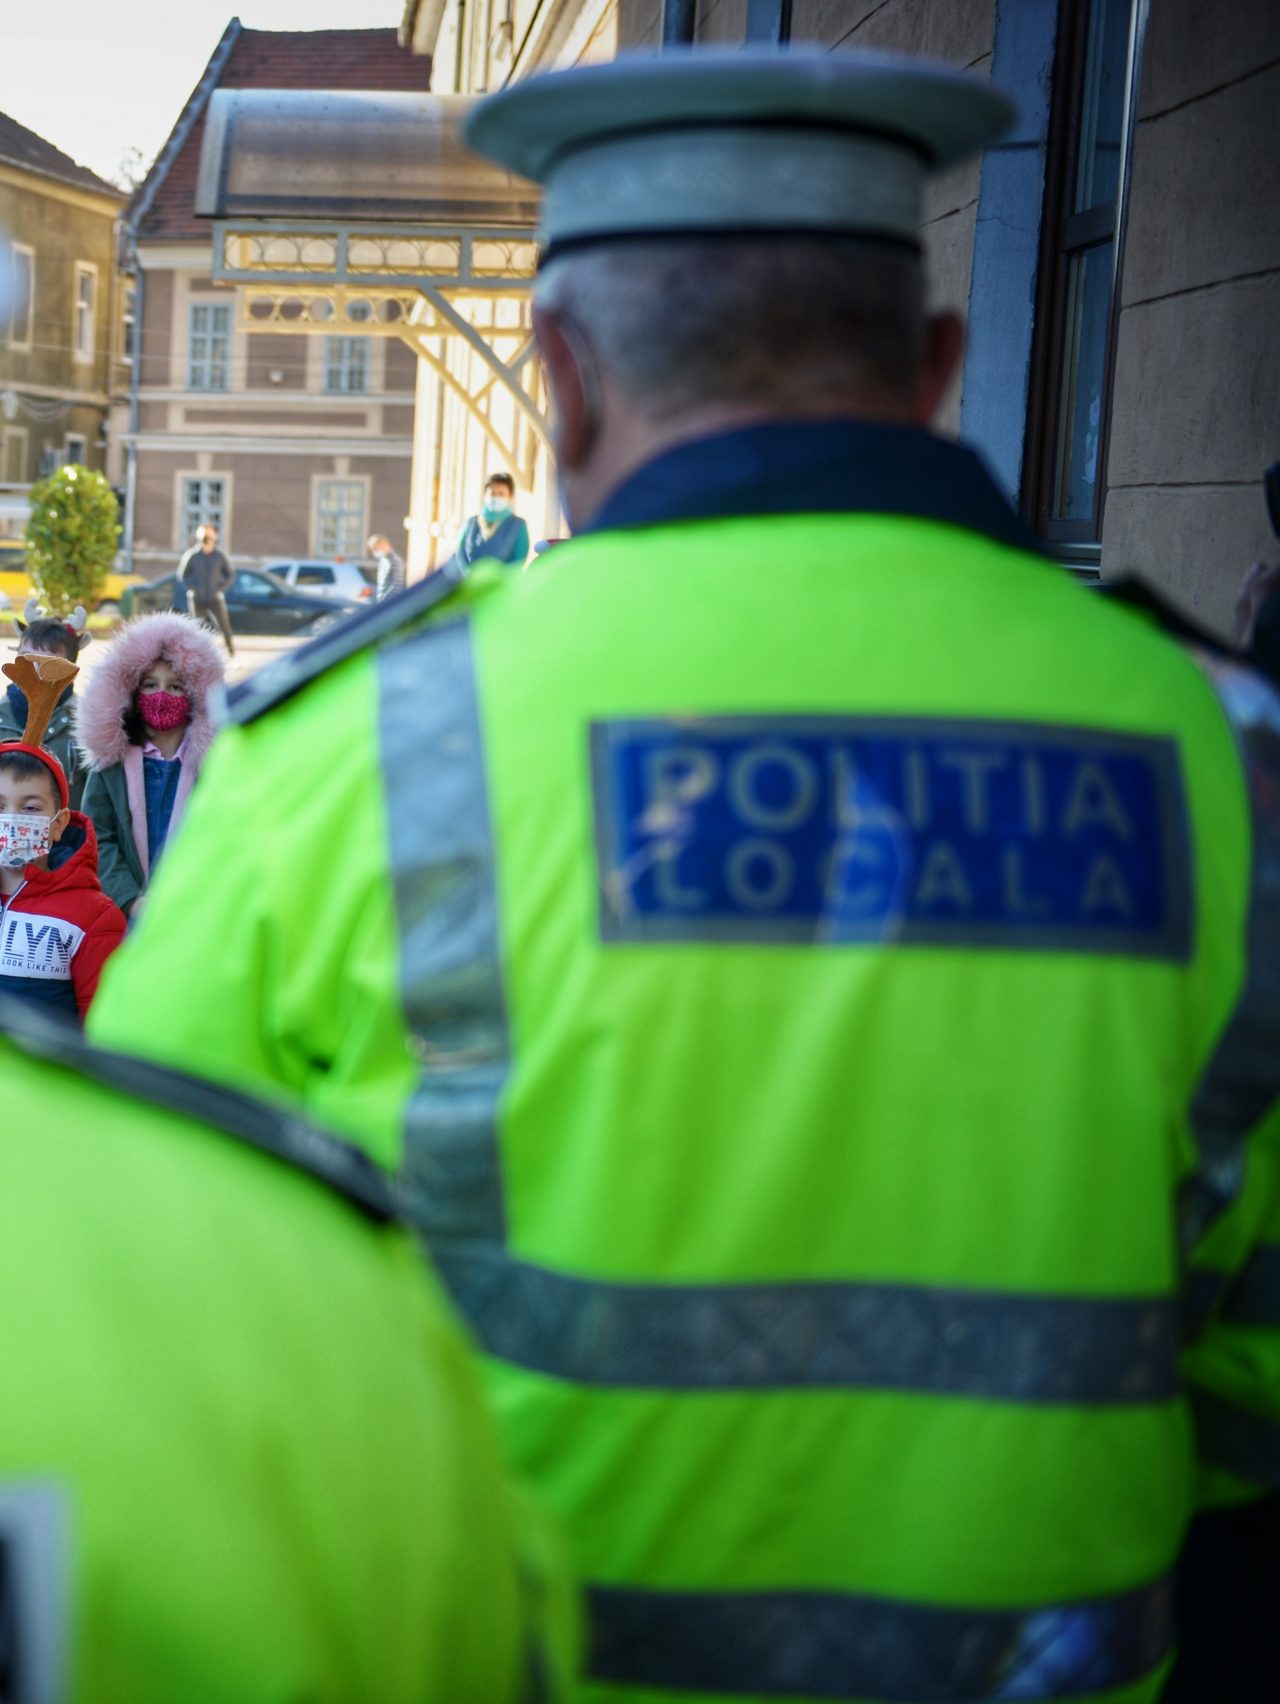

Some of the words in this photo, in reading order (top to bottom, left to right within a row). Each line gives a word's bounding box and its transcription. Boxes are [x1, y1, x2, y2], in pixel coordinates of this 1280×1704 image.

[649, 741, 1133, 843] POLITIA
[652, 838, 1134, 916] LOCALA
[2, 958, 23, 967] LOOK
[27, 963, 47, 972] LIKE
